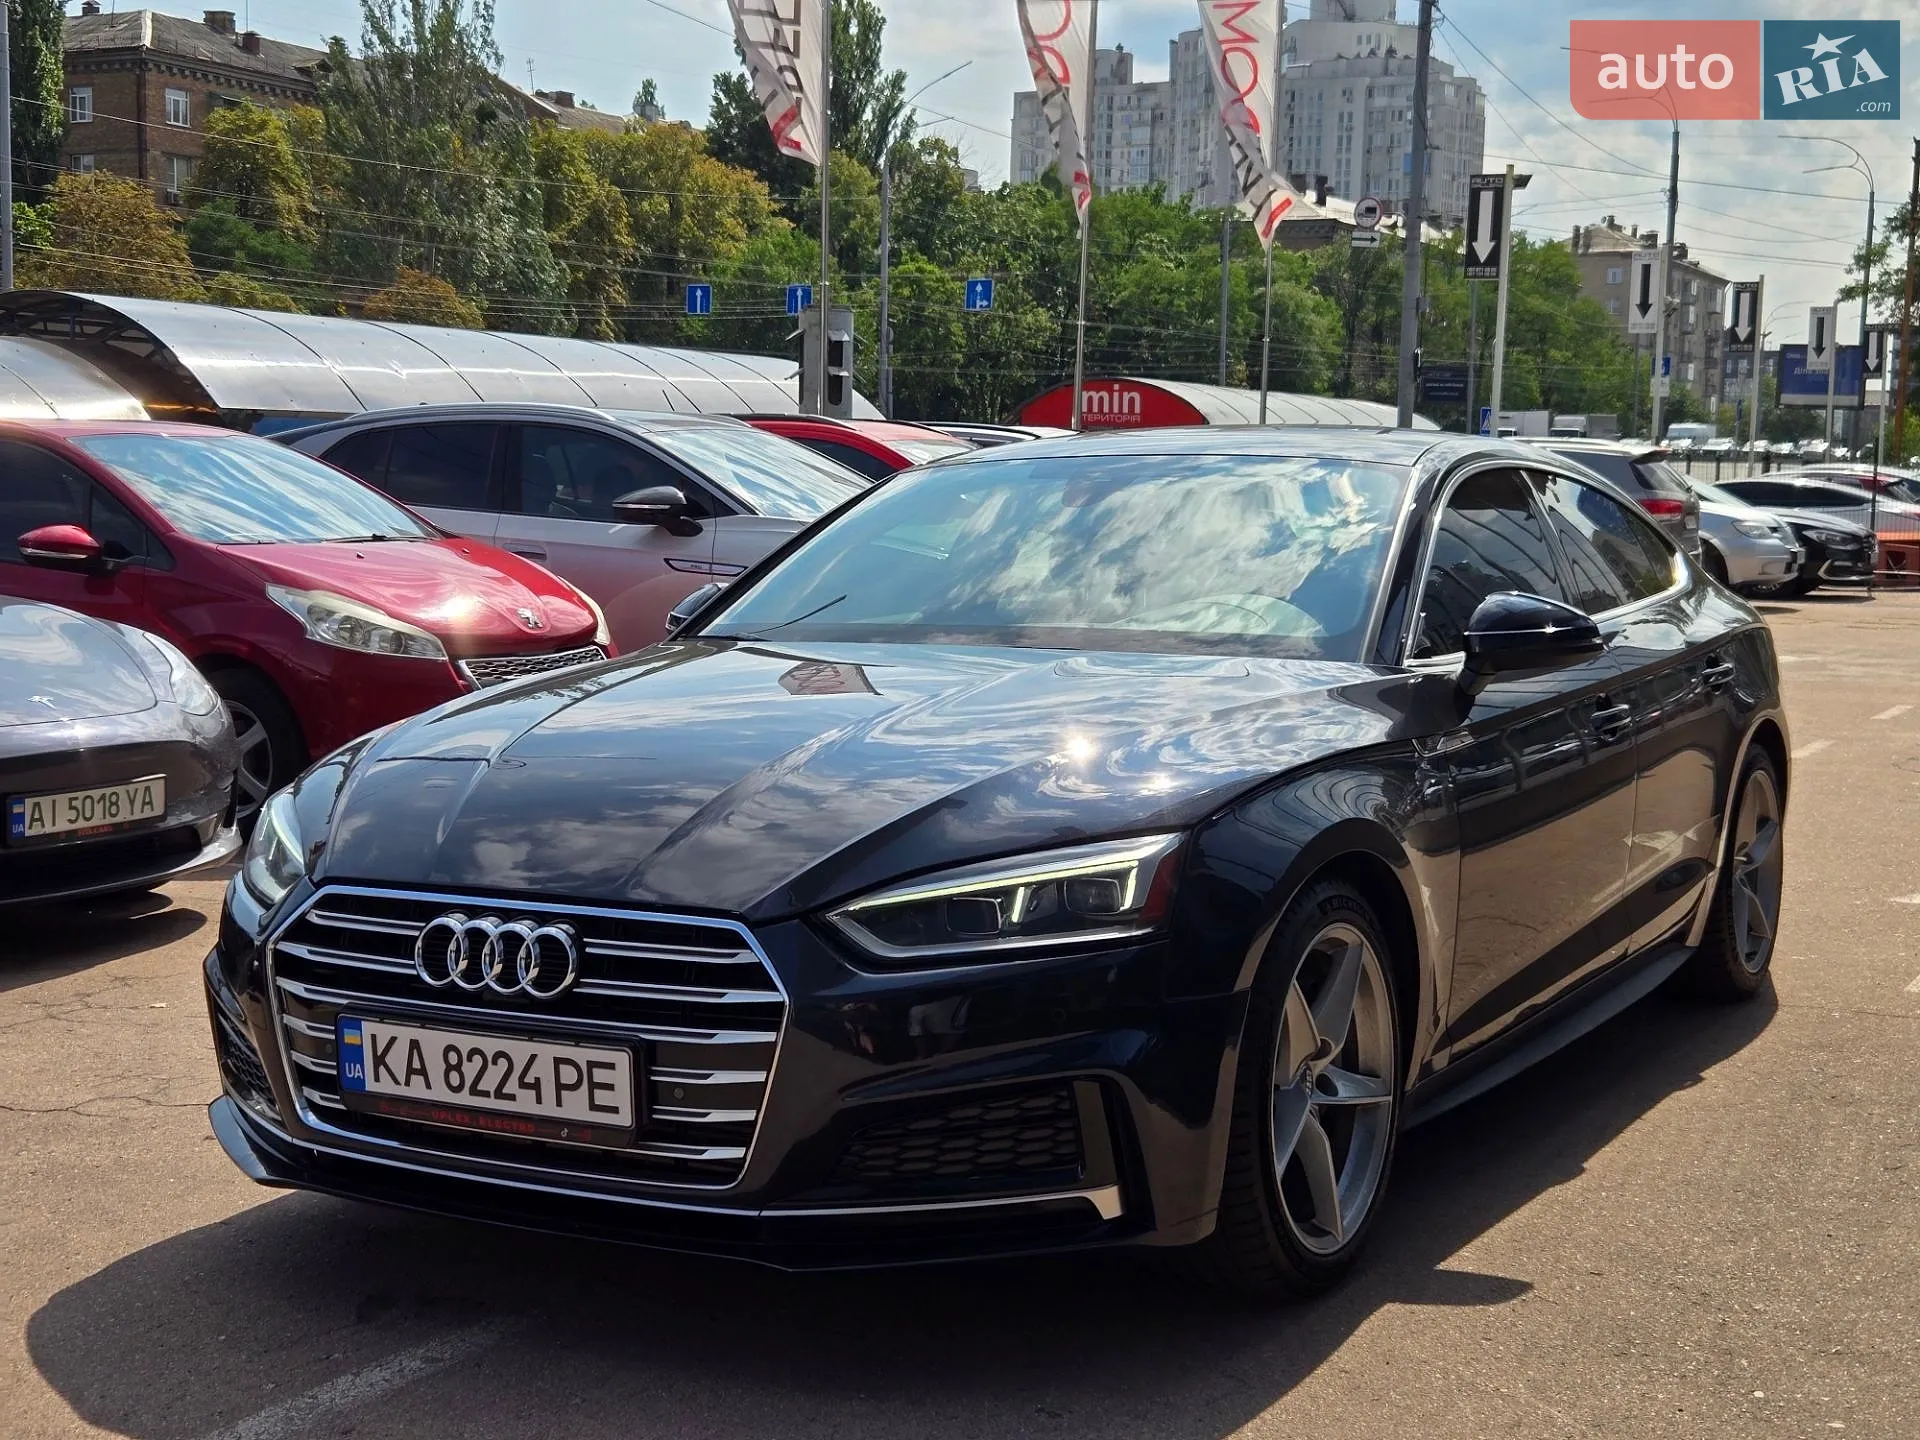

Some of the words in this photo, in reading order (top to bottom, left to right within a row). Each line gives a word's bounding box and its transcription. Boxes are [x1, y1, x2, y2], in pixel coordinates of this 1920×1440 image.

[1081, 384, 1141, 414] min
[28, 799, 57, 830] AI
[66, 791, 120, 824] 5018
[125, 785, 155, 817] YA
[12, 823, 25, 833] UA
[345, 1062, 364, 1080] UA
[370, 1033, 433, 1091] KA
[441, 1043, 543, 1105] 8224
[552, 1055, 621, 1115] PE
